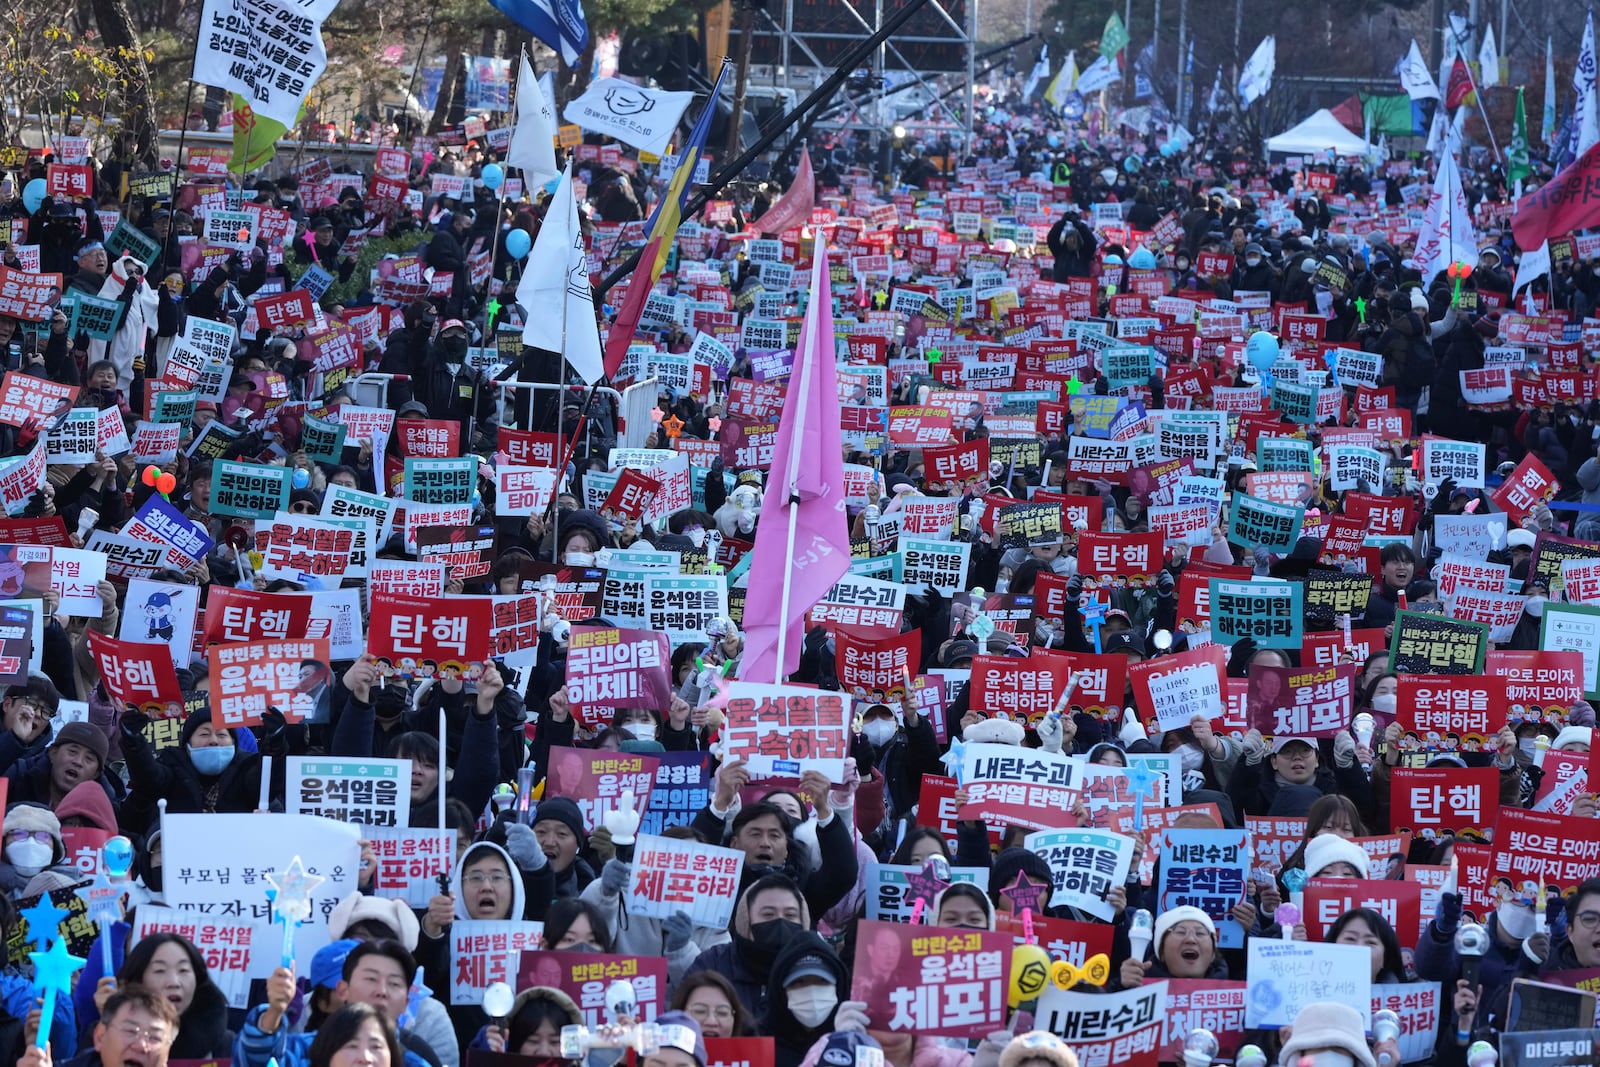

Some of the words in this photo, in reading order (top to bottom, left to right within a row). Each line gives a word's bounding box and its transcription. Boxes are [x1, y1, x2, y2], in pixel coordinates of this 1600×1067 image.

[256, 14, 315, 56] 노동자도
[258, 40, 316, 79] 사람들도
[277, 70, 305, 98] 좋은
[52, 171, 87, 193] 탄핵
[1311, 175, 1330, 187] 탄핵
[209, 218, 252, 232] 윤석열을
[1202, 257, 1228, 273] 탄핵
[264, 301, 303, 324] 탄핵
[190, 327, 231, 347] 윤석열을
[744, 325, 783, 337] 윤석열을
[1288, 321, 1318, 339] 탄핵
[744, 337, 782, 350] 탄핵하라
[850, 342, 876, 360] 탄핵
[1044, 356, 1088, 375] 국민의힘
[1108, 355, 1150, 368] 국민의힘
[1337, 355, 1377, 370] 윤석열을
[1485, 351, 1521, 362] 내란수괴
[1550, 348, 1578, 366] 탄핵
[968, 365, 1009, 380] 내란수괴
[1108, 367, 1151, 380] 해산하라
[1336, 367, 1380, 383] 탄핵하라
[1168, 377, 1204, 397] 탄핵
[1546, 379, 1575, 397] 탄핵
[4, 386, 60, 414] 윤석열
[1214, 399, 1261, 411] 체포하라
[1274, 390, 1311, 406] 국민의힘
[1358, 394, 1389, 410] 탄핵
[890, 417, 919, 432] 즉각
[1367, 417, 1403, 437] 탄핵
[406, 428, 449, 441] 윤석열을
[917, 428, 951, 444] 탄핵!
[1160, 430, 1209, 447] 윤석열을
[47, 439, 96, 455] 탄핵하라
[407, 441, 449, 456] 탄핵하라
[509, 440, 553, 464] 탄핵
[1073, 446, 1128, 459] 내란수괴
[1159, 444, 1208, 461] 탄핵하라
[1263, 448, 1309, 464] 국민의힘
[1069, 460, 1104, 472] 윤석열
[1103, 461, 1132, 473] 탄핵!
[1337, 454, 1381, 471] 윤석열을
[1430, 450, 1479, 466] 윤석열을
[221, 472, 282, 491] 국민의힘
[412, 469, 471, 485] 국민의힘
[1337, 470, 1379, 486] 탄핵하라
[1430, 466, 1479, 481] 탄핵하라
[412, 488, 470, 503] 해산하라
[1182, 484, 1219, 496] 내란수괴
[218, 491, 281, 509] 해산하라
[905, 502, 934, 514] 내란범
[902, 511, 956, 533] 체포하라
[1151, 512, 1180, 524] 내란범
[1181, 506, 1209, 519] 윤석열
[1237, 510, 1294, 537] 국민의힘
[1369, 505, 1404, 532] 탄핵
[143, 506, 206, 555] 청년명령
[271, 522, 352, 552] 윤석열을
[1235, 526, 1290, 552] 해산하라
[92, 541, 162, 565] 내란수괴
[452, 541, 472, 552] 비호
[472, 539, 493, 549] 검찰
[271, 548, 349, 578] 구속하라
[423, 550, 481, 567] 사건에서
[905, 549, 962, 571] 윤석열을
[1093, 544, 1149, 572] 탄핵
[371, 569, 402, 582] 내란범
[404, 569, 441, 580] 윤석열
[449, 560, 491, 579] 손떼라
[1442, 563, 1471, 578] 내란범
[1472, 566, 1505, 579] 윤석열
[1565, 567, 1594, 581] 내란범
[577, 581, 600, 593] 검찰
[903, 570, 960, 589] 탄핵하라
[651, 591, 720, 610] 윤석열을
[1218, 594, 1293, 617] 국민의힘
[1455, 595, 1492, 610] 내란범
[1492, 598, 1524, 612] 윤석열
[222, 606, 290, 642] 탄핵
[810, 604, 859, 625] 윤석열
[861, 608, 899, 629] 탄핵!
[389, 614, 468, 656] 탄핵
[1218, 617, 1293, 637] 해산하라
[1402, 629, 1440, 641] 내란수괴
[1448, 631, 1479, 644] 윤석열
[569, 629, 620, 647] 내란공범
[218, 644, 265, 661] 반민주
[268, 642, 315, 660] 반헌법
[568, 643, 661, 673] 국민의힘
[844, 645, 908, 669] 윤석열을
[100, 654, 160, 699] 탄핵
[220, 662, 301, 693] 윤석열
[985, 671, 1054, 690] 윤석열을
[1288, 668, 1337, 688] 반란수괴
[1537, 669, 1575, 685] 모이자
[566, 673, 639, 703] 해체!
[1295, 676, 1350, 704] 윤석열
[1542, 686, 1581, 702] 모이자
[220, 693, 270, 725] 탄핵
[271, 691, 313, 720] 구속
[984, 691, 1055, 711] 탄핵하라
[1154, 694, 1176, 709] 살기
[1179, 689, 1198, 702] 좋은
[1414, 689, 1489, 711] 윤석열을
[582, 704, 615, 723] 탄핵
[726, 695, 844, 729] 윤석열을
[1273, 698, 1350, 736] 체포!
[1414, 711, 1489, 733] 탄핵하라
[728, 729, 847, 762] 구속하라
[591, 759, 643, 774] 반란수괴
[973, 756, 1073, 788] 내란수괴
[300, 783, 398, 811] 윤석열을
[965, 782, 1027, 806] 윤석열
[1028, 786, 1078, 813] 탄핵!
[1409, 784, 1481, 825] 탄핵
[1172, 844, 1238, 864] 내란수괴
[1508, 830, 1558, 857] 빛으로
[1560, 837, 1600, 860] 모이자
[639, 849, 689, 874] 내란범
[691, 855, 738, 875] 윤석열
[1495, 851, 1512, 872] 될
[1514, 855, 1561, 879] 때까지
[1562, 862, 1600, 882] 모이자
[178, 868, 231, 884] 부모님
[330, 864, 346, 883] 온
[1166, 867, 1243, 894] 윤석열
[633, 868, 735, 904] 체포하라
[199, 926, 253, 946] 윤석열
[457, 933, 507, 954] 내란범
[911, 933, 982, 958] 반란수괴
[572, 960, 637, 982] 반란수괴
[921, 951, 1003, 987] 윤석열
[888, 981, 1002, 1035] 체포!
[1190, 991, 1244, 1006] 국민의힘
[1385, 989, 1435, 1011] 윤석열
[1048, 991, 1158, 1041] 내란수괴
[1112, 1021, 1158, 1059] 탄핵!
[1525, 1040, 1592, 1059] 미친듯이
